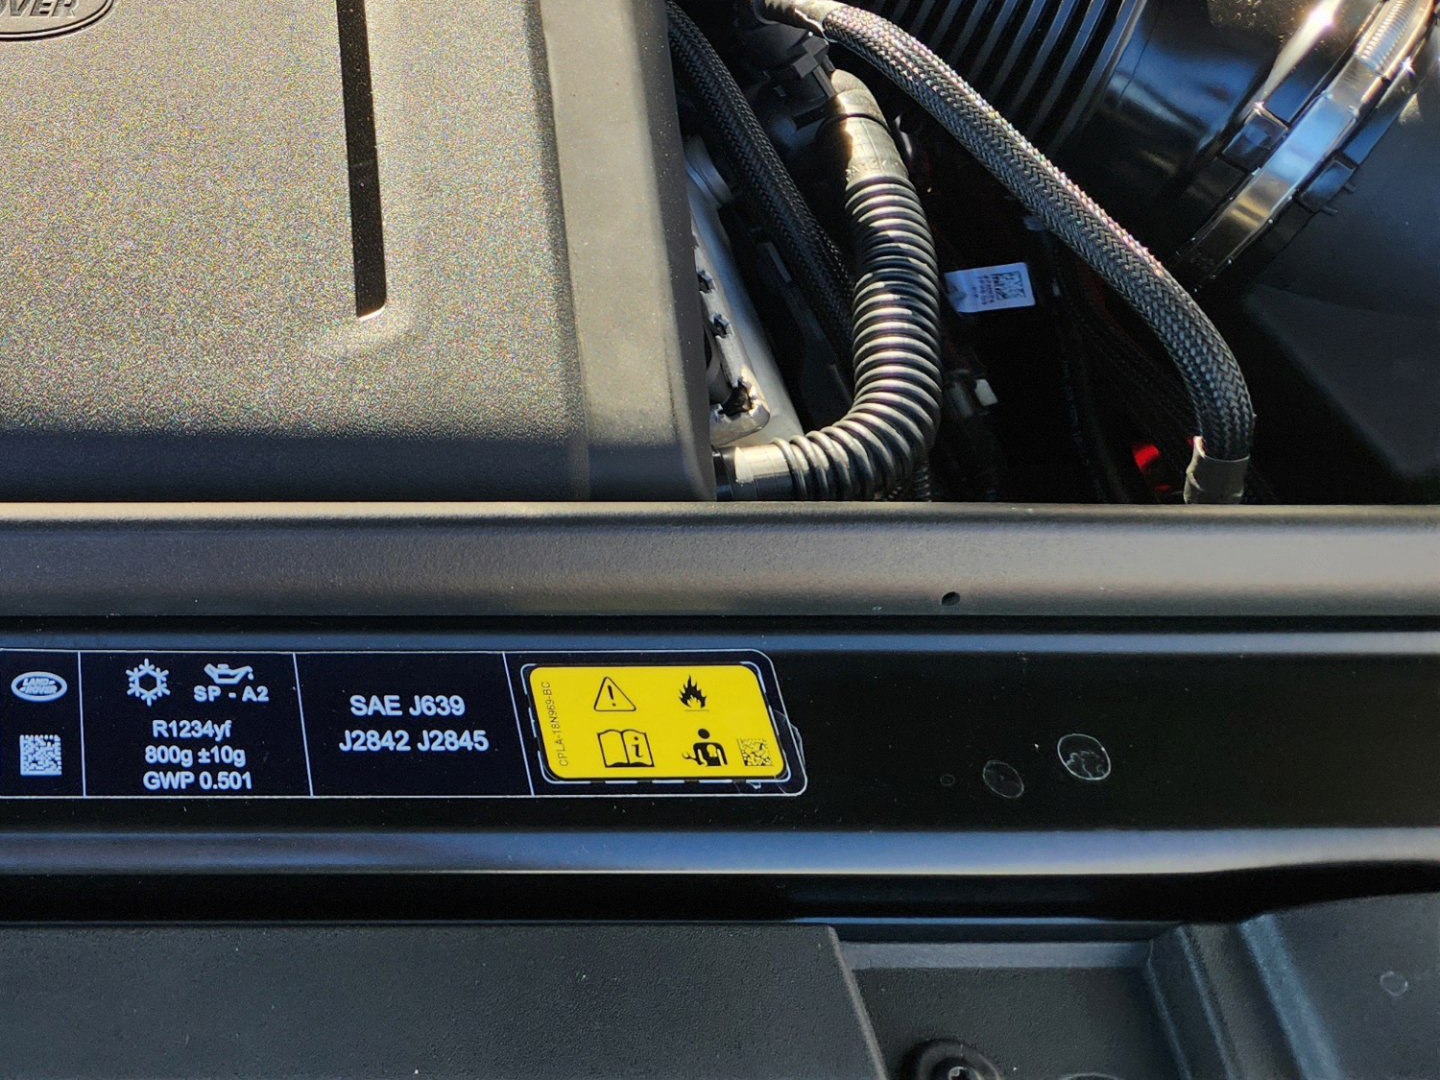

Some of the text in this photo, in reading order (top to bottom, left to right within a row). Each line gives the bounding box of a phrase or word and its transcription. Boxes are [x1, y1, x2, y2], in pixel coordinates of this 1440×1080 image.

[193, 685, 221, 702] SP
[242, 685, 270, 702] A2
[349, 694, 466, 716] SAE J639
[152, 719, 232, 742] R1234yf
[338, 729, 490, 752] J2842 J2845
[145, 745, 246, 767] 800g ±10g
[142, 771, 252, 790] GWP 0.501
